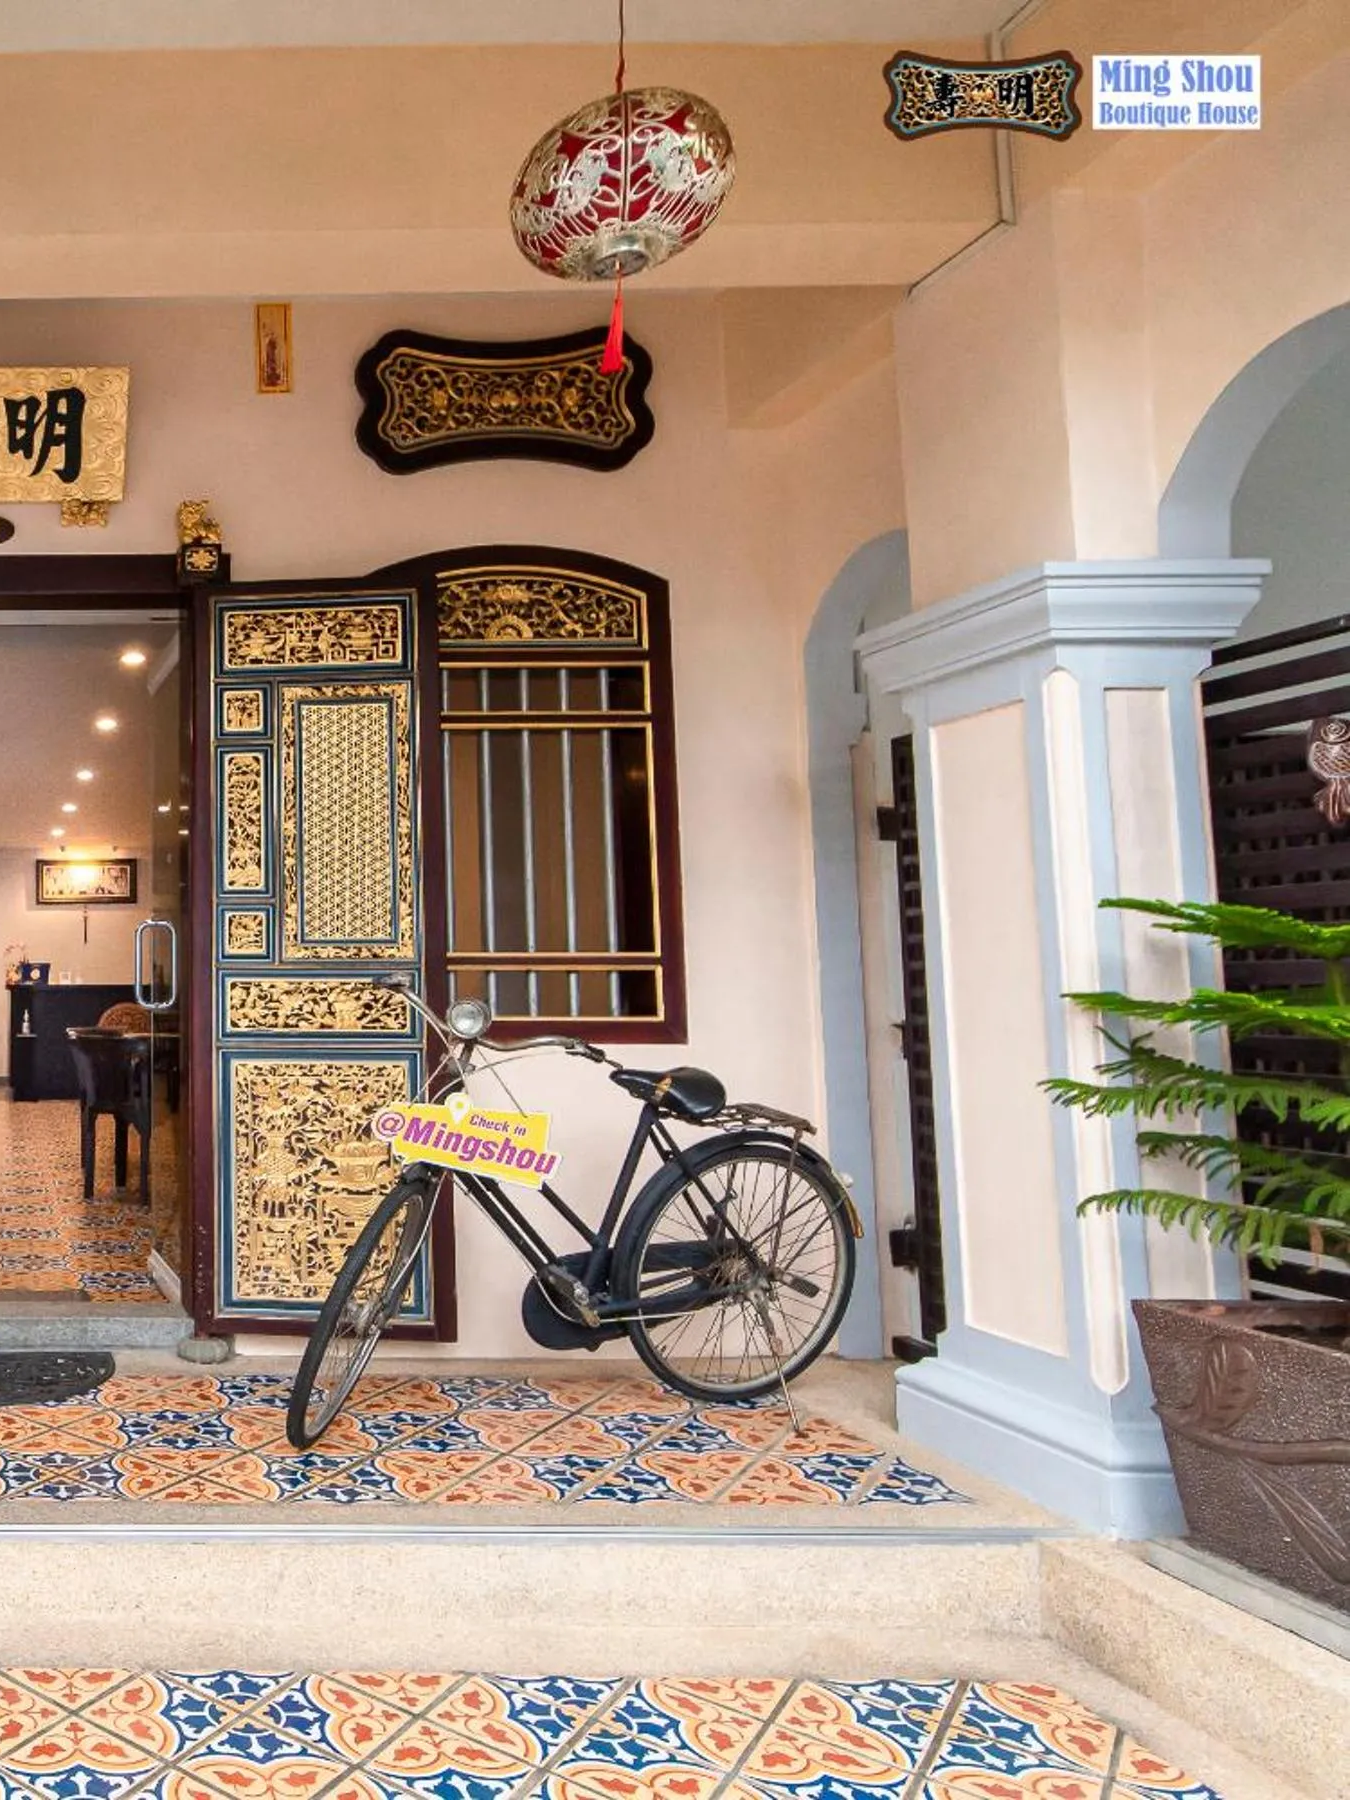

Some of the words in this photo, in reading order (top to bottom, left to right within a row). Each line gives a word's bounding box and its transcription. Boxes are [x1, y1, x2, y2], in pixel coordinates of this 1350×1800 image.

[376, 1111, 557, 1175] @Mingshou
[469, 1114, 511, 1133] Check
[514, 1126, 527, 1137] in
